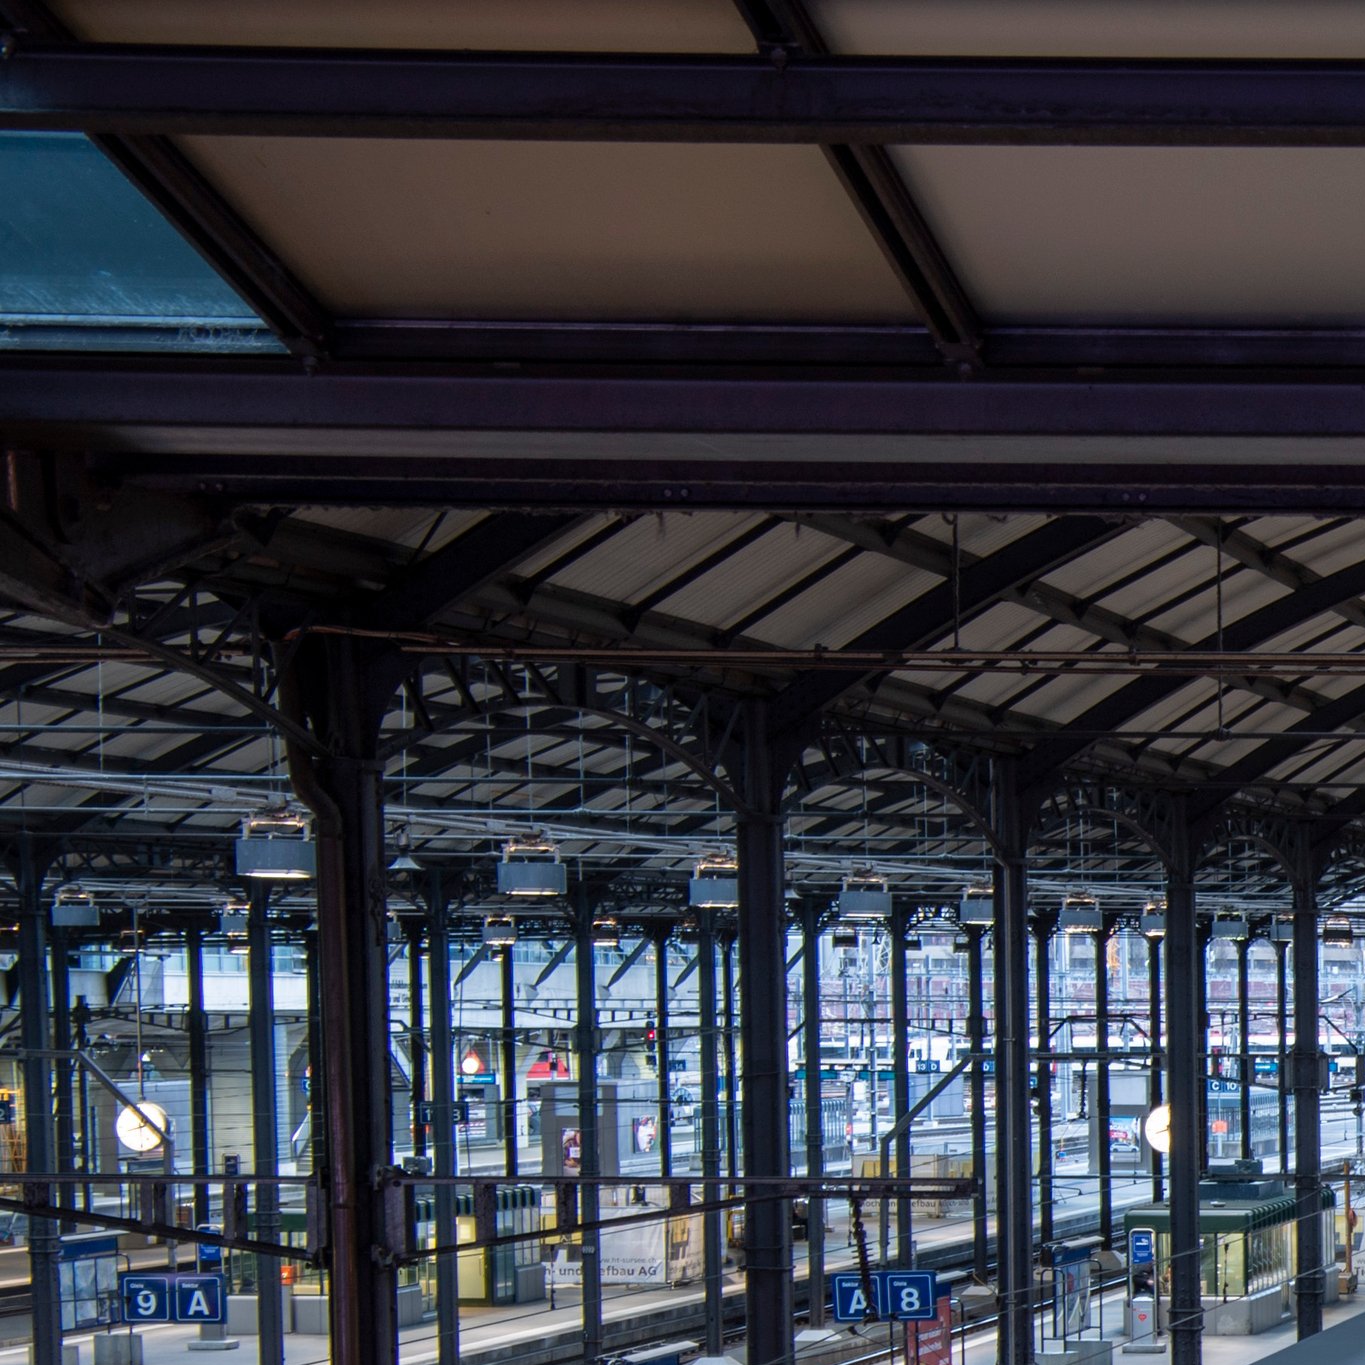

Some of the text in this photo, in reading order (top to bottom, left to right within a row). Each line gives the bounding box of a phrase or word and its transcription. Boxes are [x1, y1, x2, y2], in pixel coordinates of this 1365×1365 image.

[1212, 1082, 1237, 1090] C 10
[137, 1290, 210, 1316] 9 A
[849, 1288, 920, 1314] A 8
